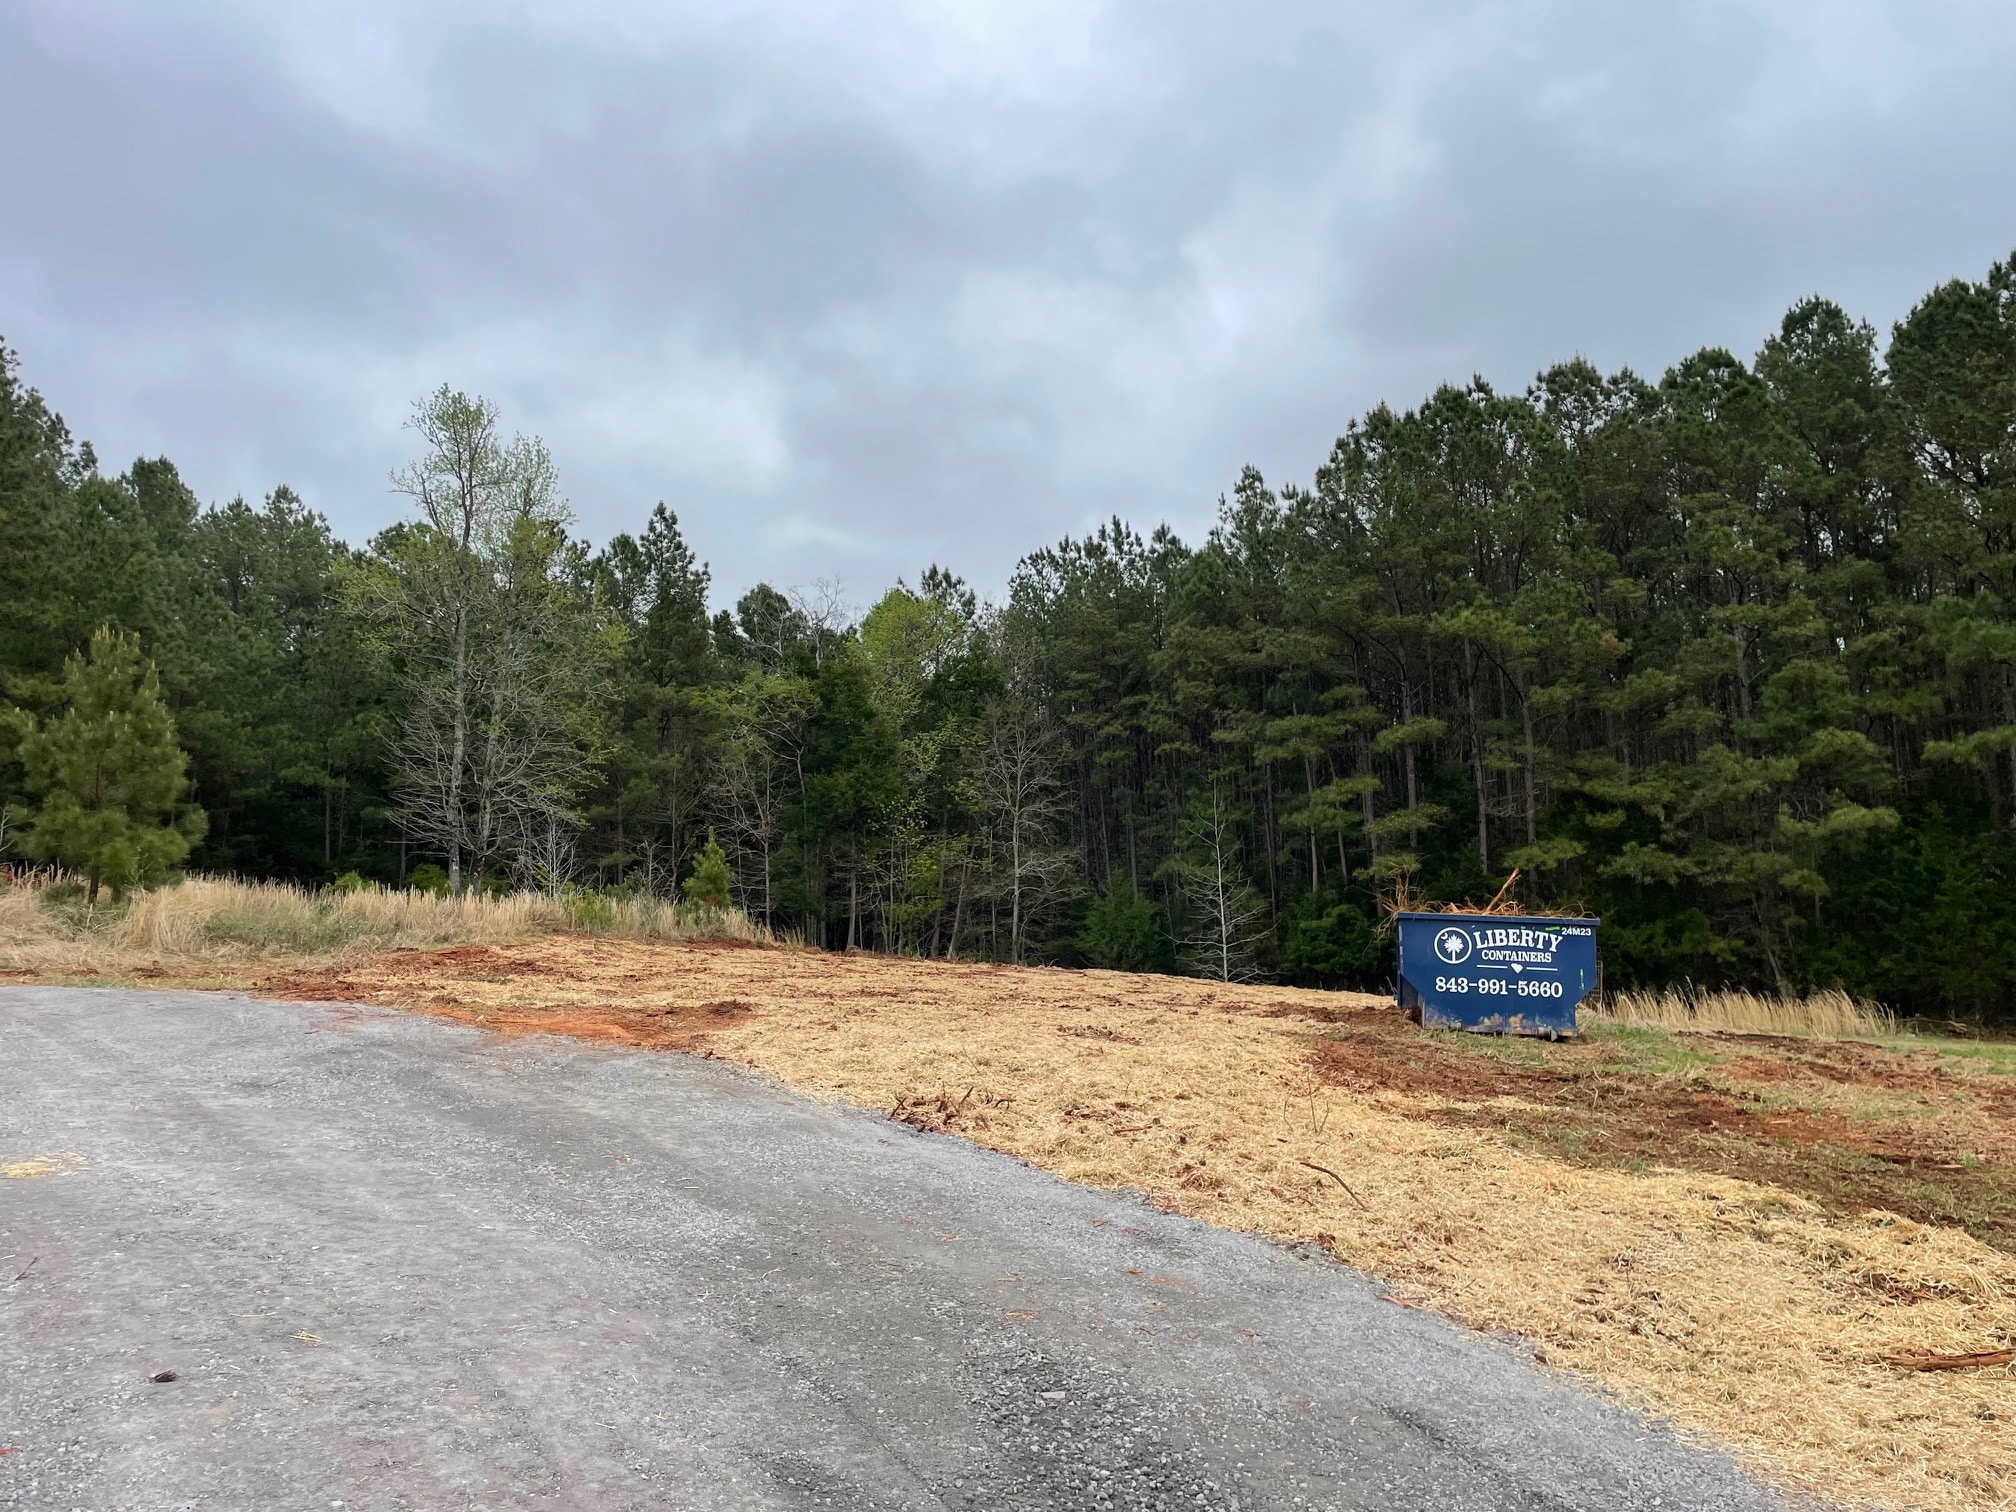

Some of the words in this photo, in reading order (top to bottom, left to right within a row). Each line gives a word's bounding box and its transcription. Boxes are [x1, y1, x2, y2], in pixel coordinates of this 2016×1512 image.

[1473, 928, 1563, 952] LIBERTY
[1561, 927, 1592, 936] 24M23
[1481, 949, 1552, 963] CONTAINERS
[1435, 976, 1563, 998] 843-991-5660
